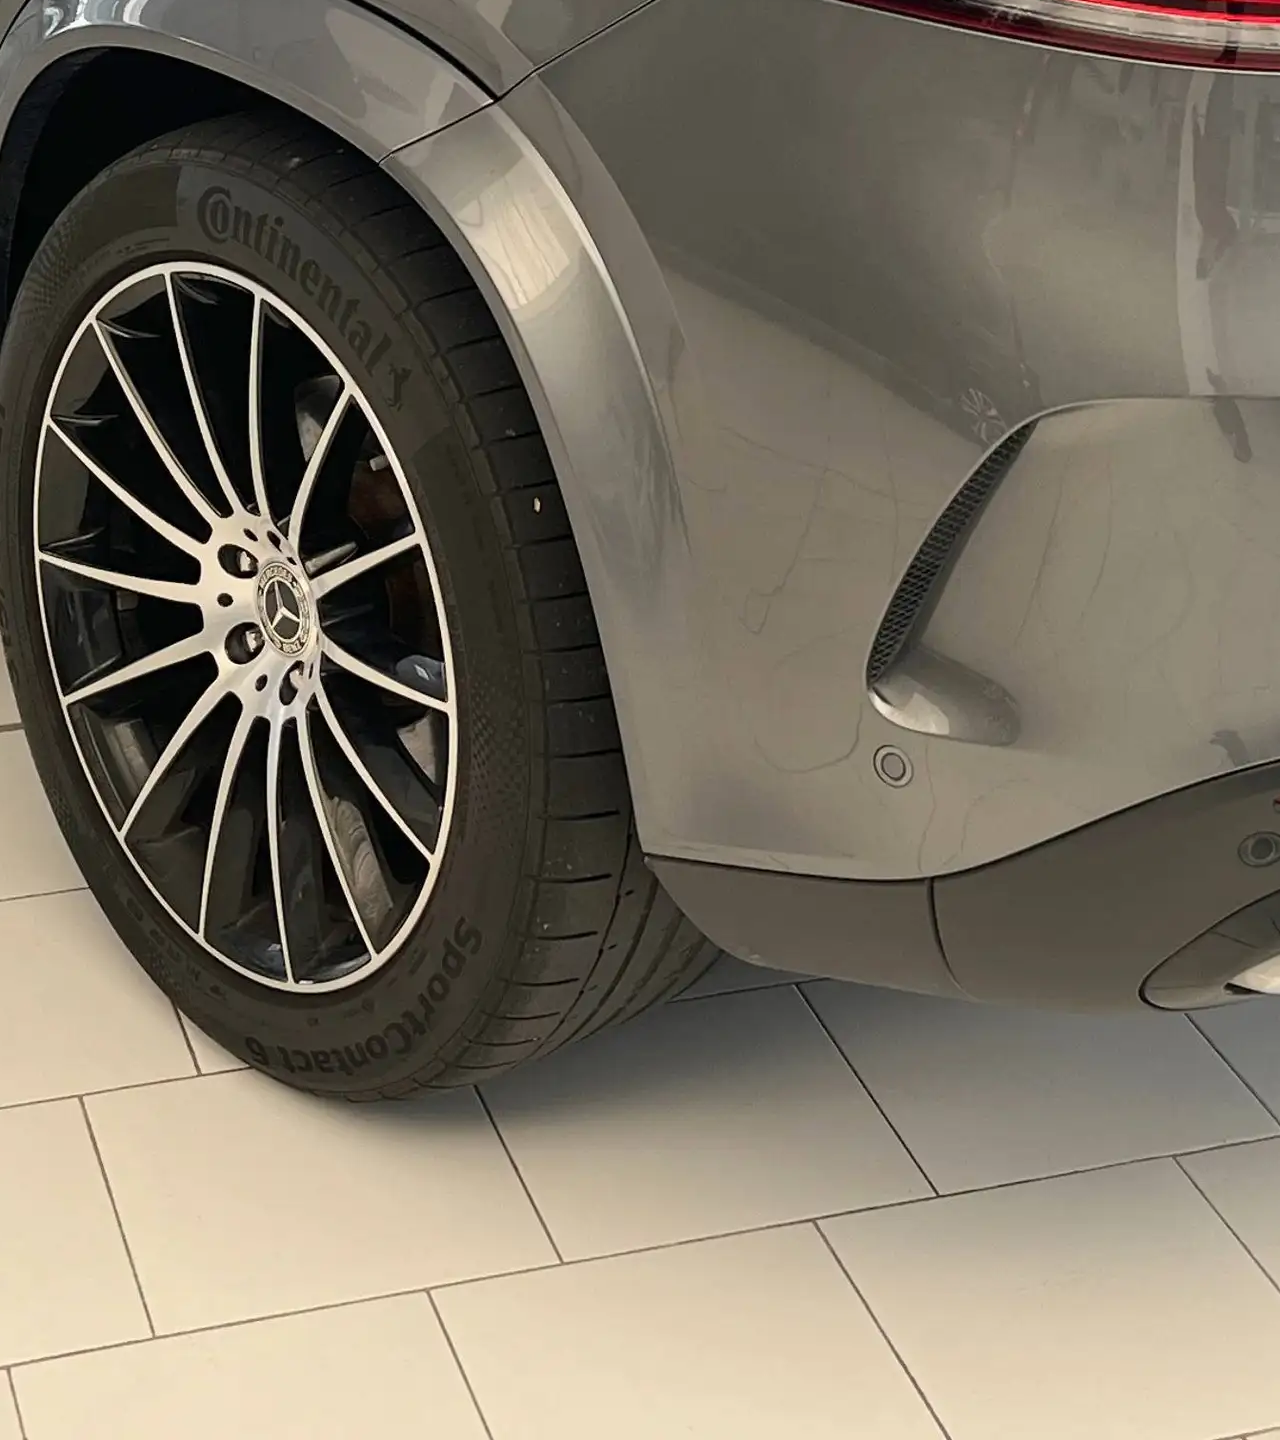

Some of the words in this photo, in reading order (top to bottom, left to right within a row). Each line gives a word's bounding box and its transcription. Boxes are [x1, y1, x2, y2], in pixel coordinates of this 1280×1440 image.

[196, 185, 393, 377] Continental
[245, 1036, 270, 1066] 6
[276, 916, 483, 1076] SportContact
